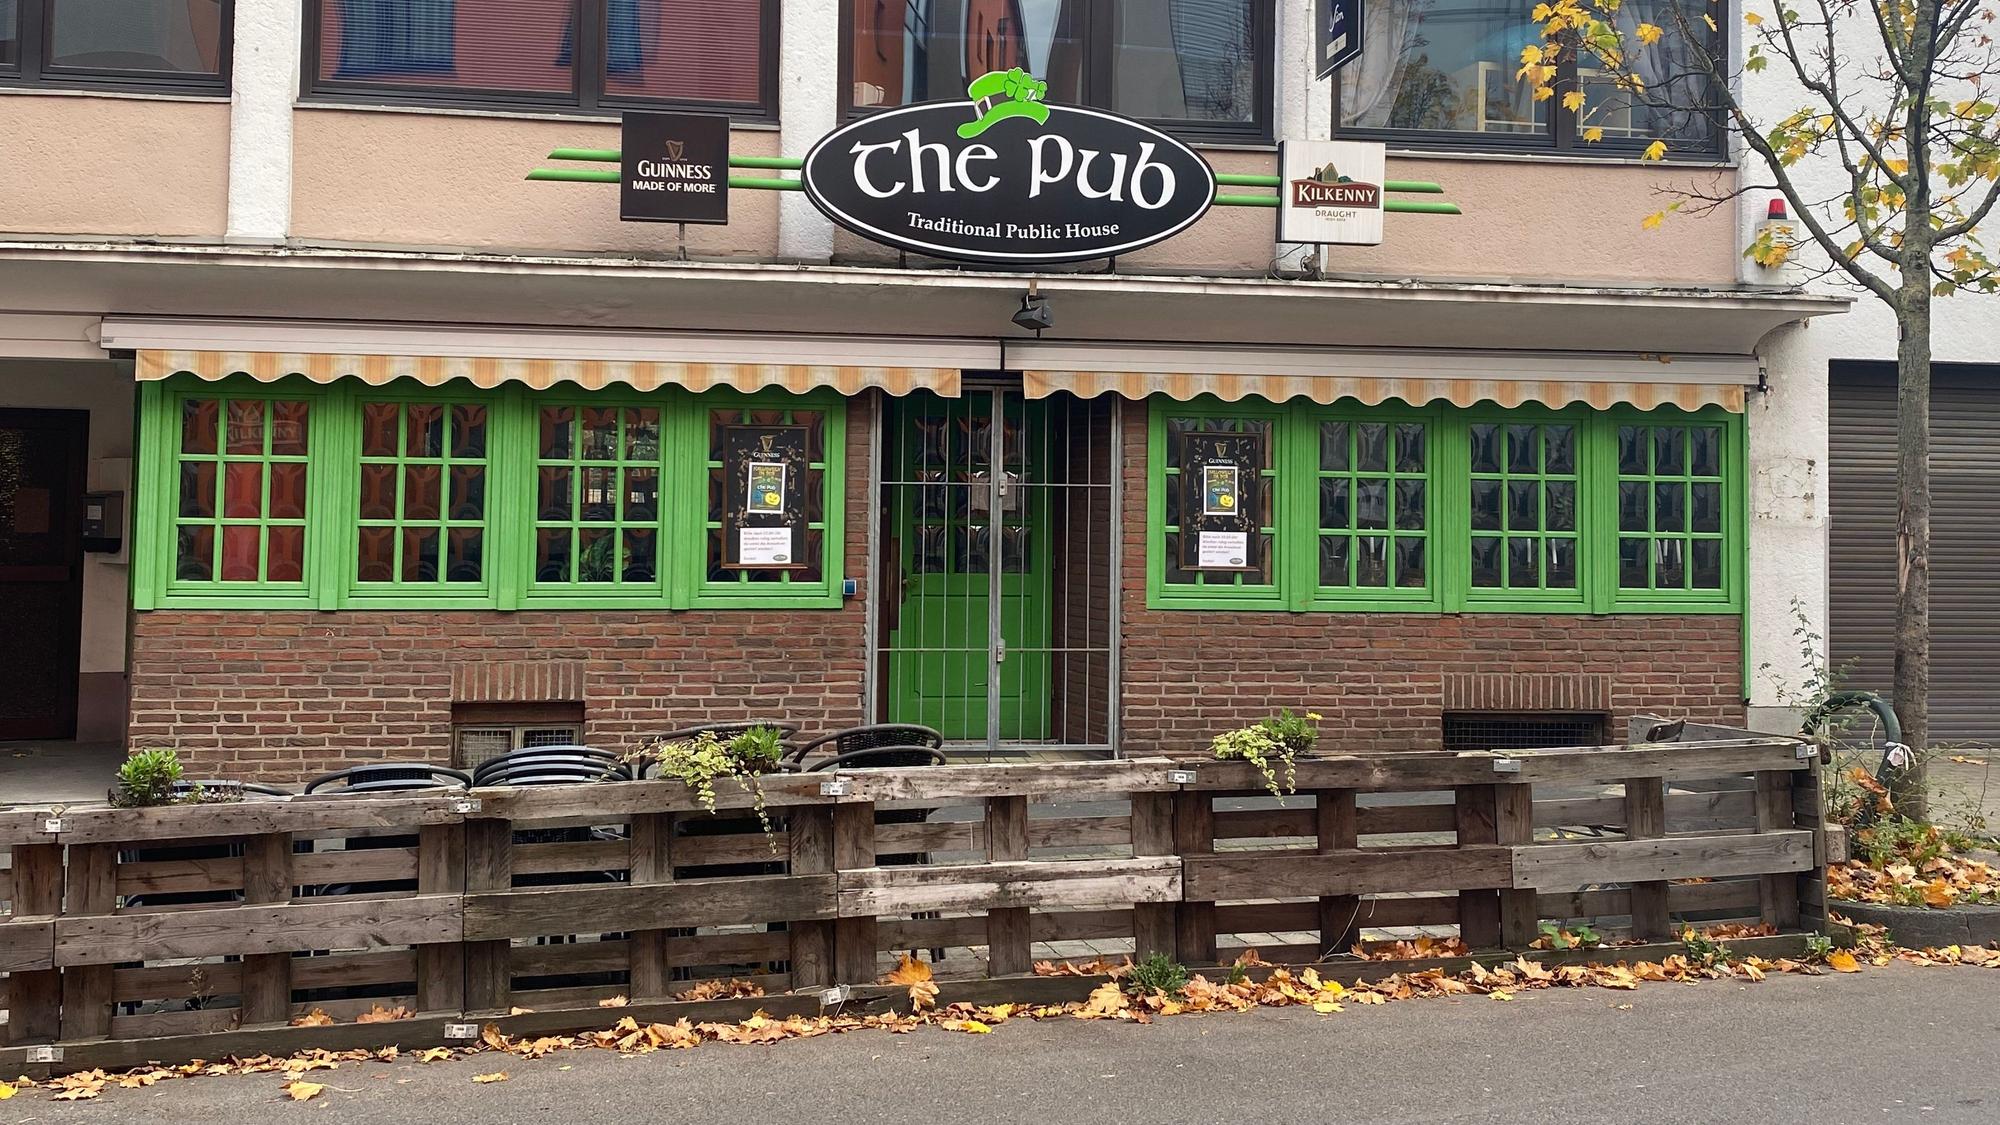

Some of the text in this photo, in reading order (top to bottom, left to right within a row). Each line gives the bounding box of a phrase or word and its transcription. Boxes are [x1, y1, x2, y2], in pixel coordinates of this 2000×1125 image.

[637, 160, 712, 180] GUINNESS
[849, 128, 1176, 210] The Pub
[633, 180, 716, 193] MADE OF MORE
[1298, 184, 1376, 203] KILKENNY
[1315, 210, 1357, 218] DRAUGHT
[908, 212, 1120, 240] Traditional Public House
